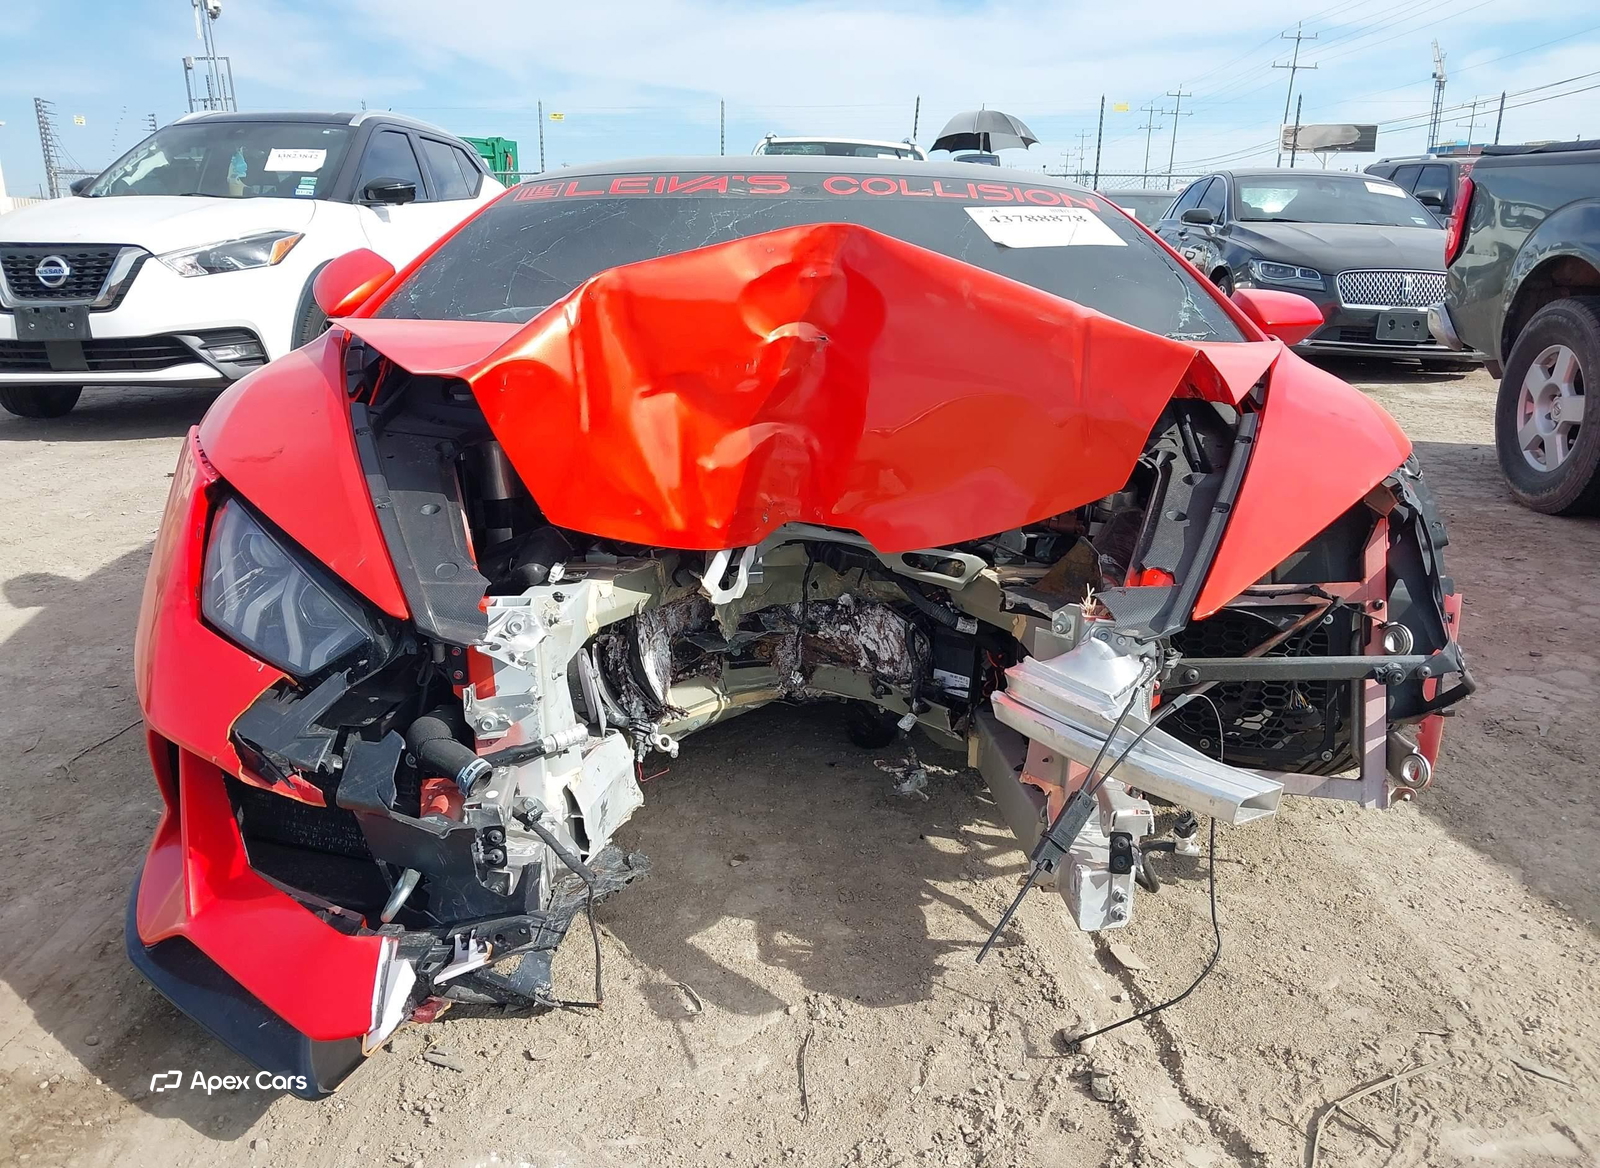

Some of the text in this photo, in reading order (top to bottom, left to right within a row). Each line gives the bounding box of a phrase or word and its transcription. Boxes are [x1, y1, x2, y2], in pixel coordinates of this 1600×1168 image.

[564, 175, 1102, 212] LEIVA'S COLLISION
[988, 214, 1088, 223] 43788878
